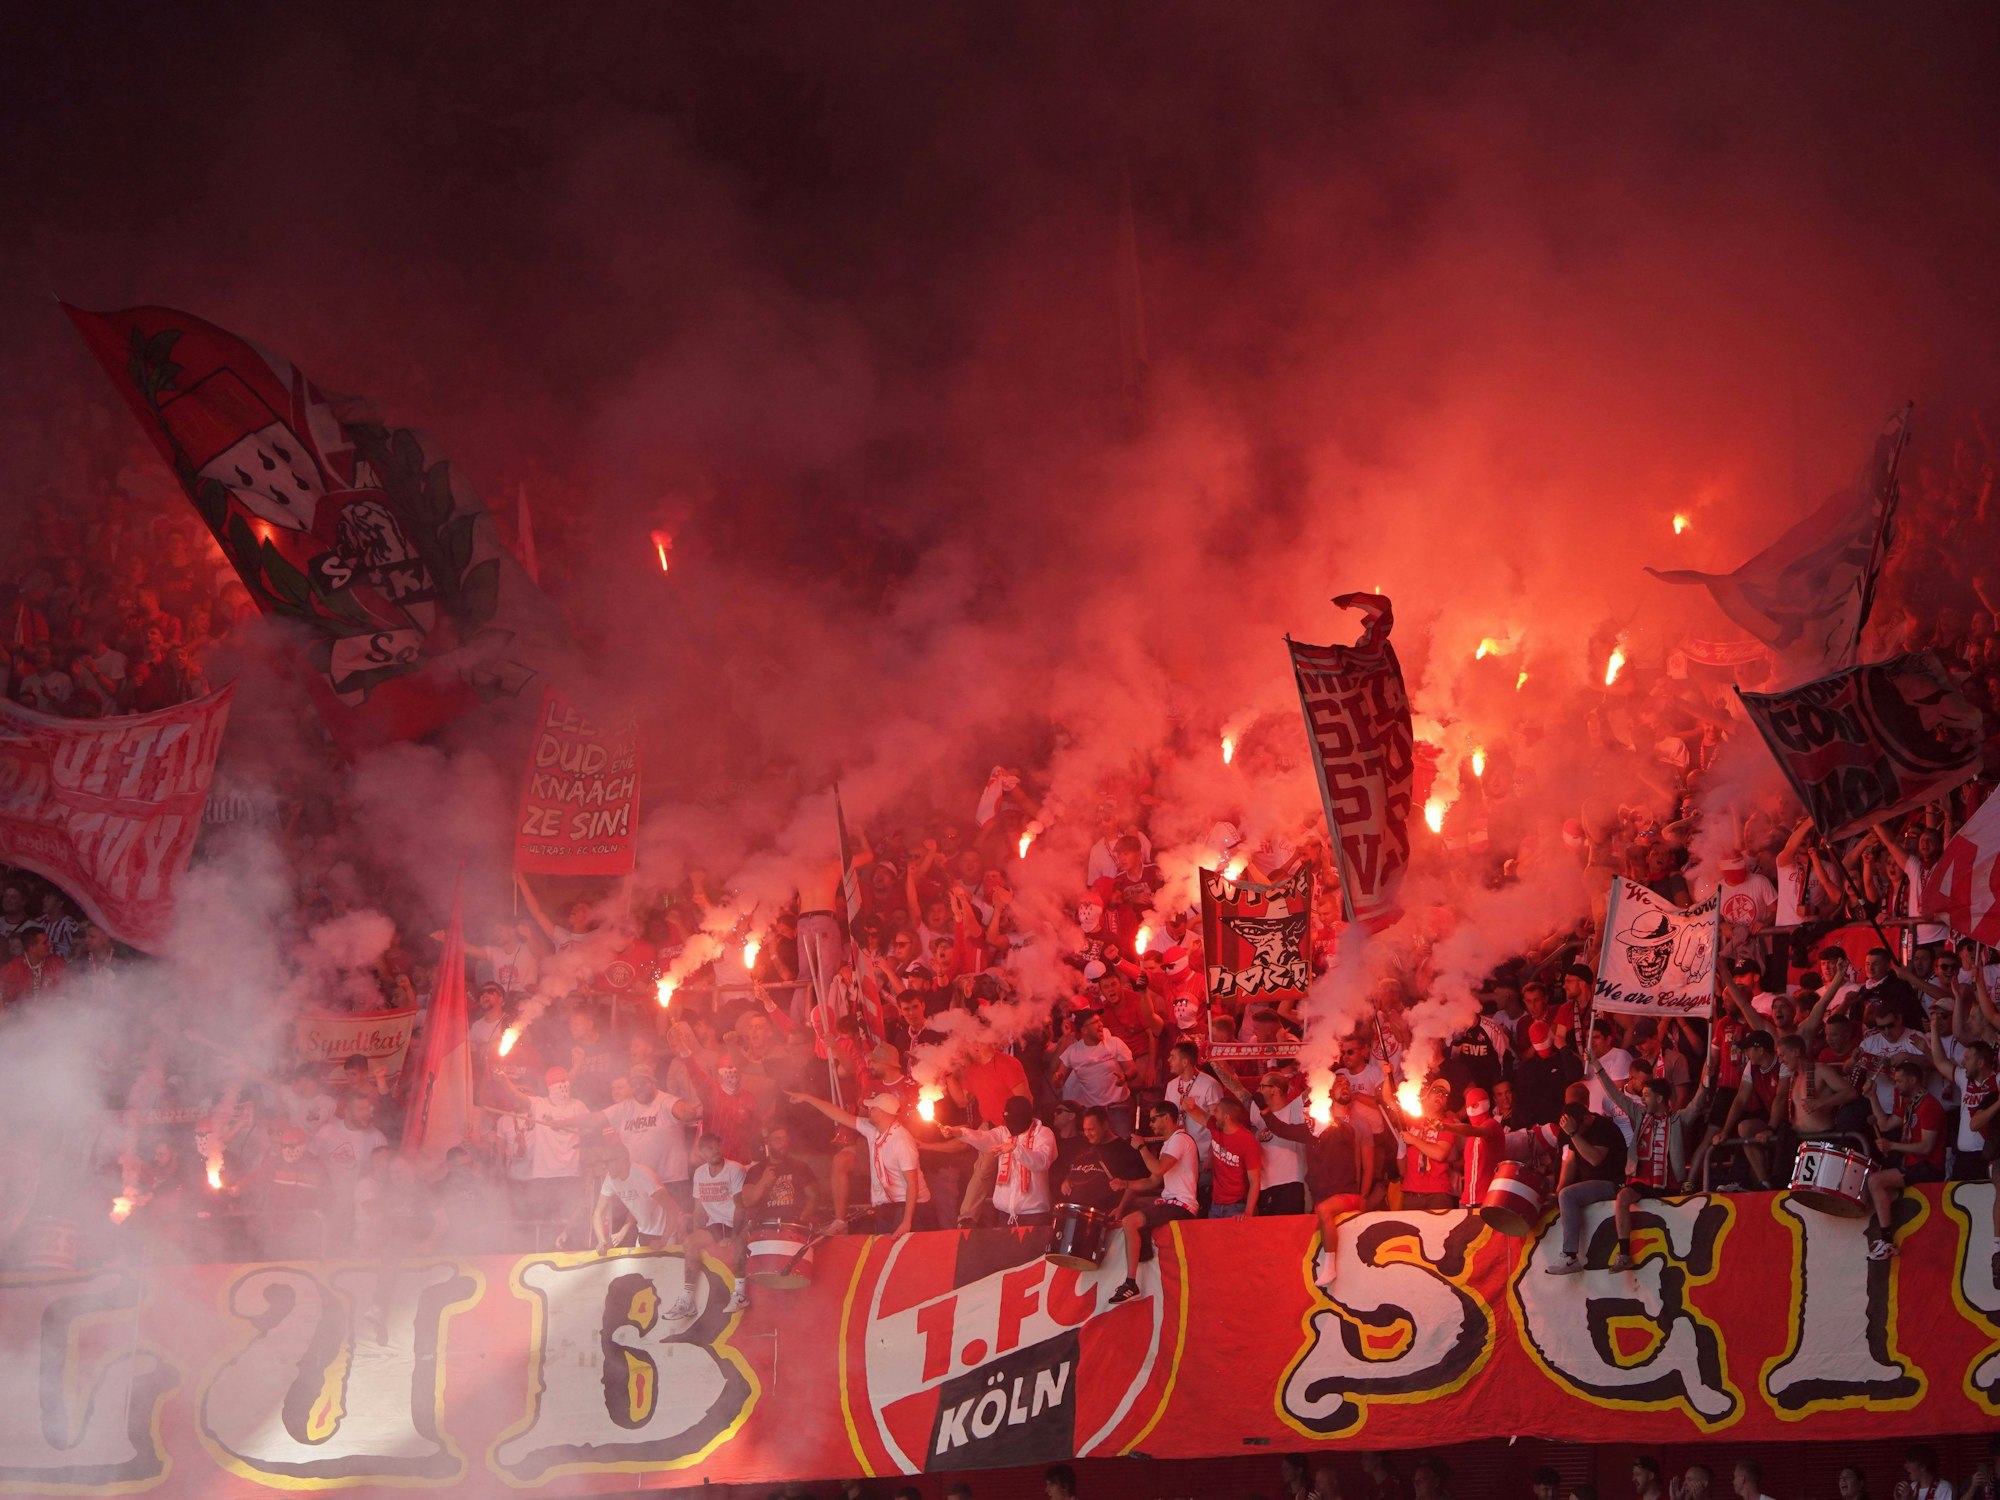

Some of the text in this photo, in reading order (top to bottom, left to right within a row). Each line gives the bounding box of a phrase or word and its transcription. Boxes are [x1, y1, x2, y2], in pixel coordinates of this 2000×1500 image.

[535, 733, 608, 776] DUD
[610, 756, 635, 774] ENE
[530, 772, 636, 808] KNÄÄCH
[522, 803, 630, 841] ZE SIN!
[529, 845, 565, 857] ULTRAS
[577, 846, 588, 856] FC
[592, 842, 618, 855] KÖLN
[1626, 882, 1651, 905] We
[1594, 977, 1621, 1001] We
[1624, 992, 1653, 1005] are
[308, 1029, 406, 1057] Syndikat
[624, 1115, 658, 1131] UNFAIR
[935, 1362, 1070, 1456] KÖLN
